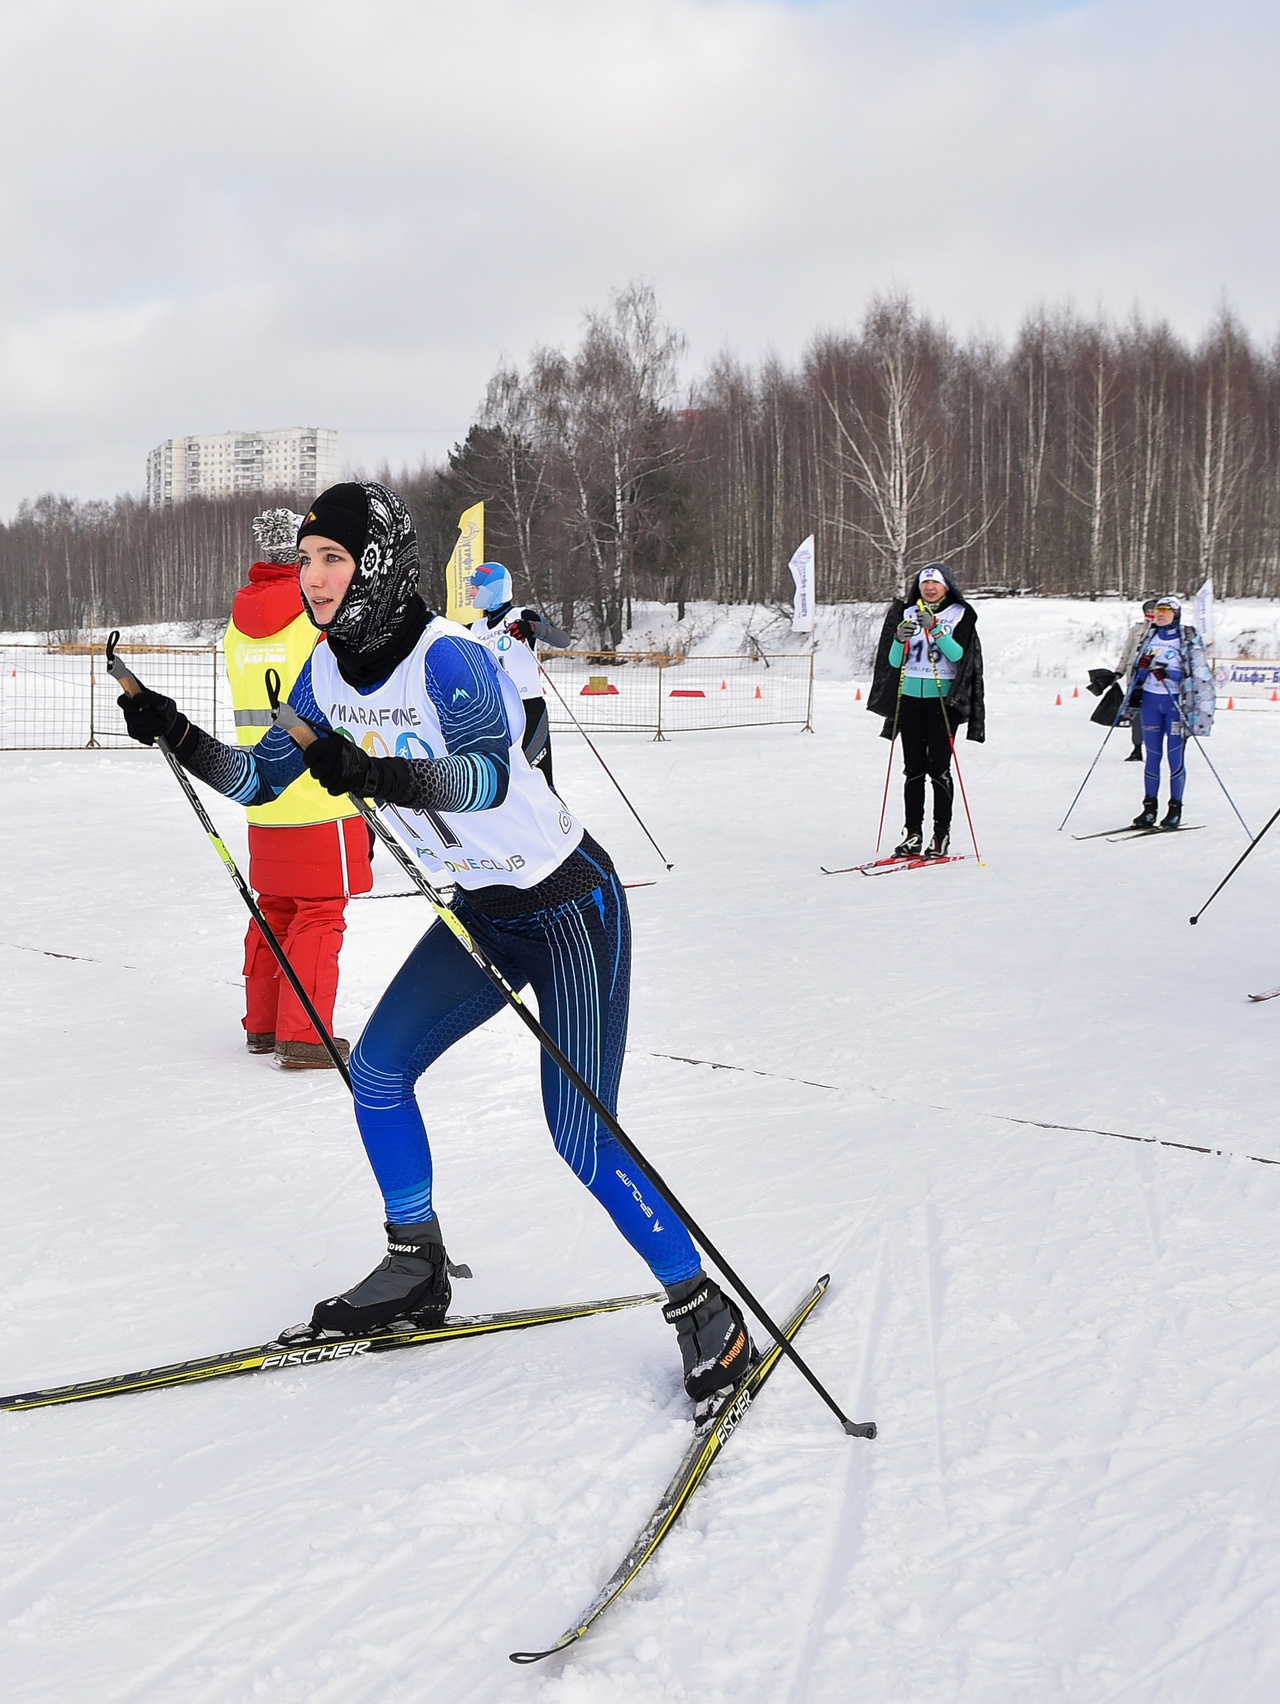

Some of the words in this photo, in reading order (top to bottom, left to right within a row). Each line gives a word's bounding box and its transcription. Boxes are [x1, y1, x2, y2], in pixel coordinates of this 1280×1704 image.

[666, 1287, 709, 1320] NORDWAY
[260, 1341, 371, 1370] FISCHER
[720, 1329, 747, 1369] NORDWAY
[715, 1388, 755, 1447] FISCHER
